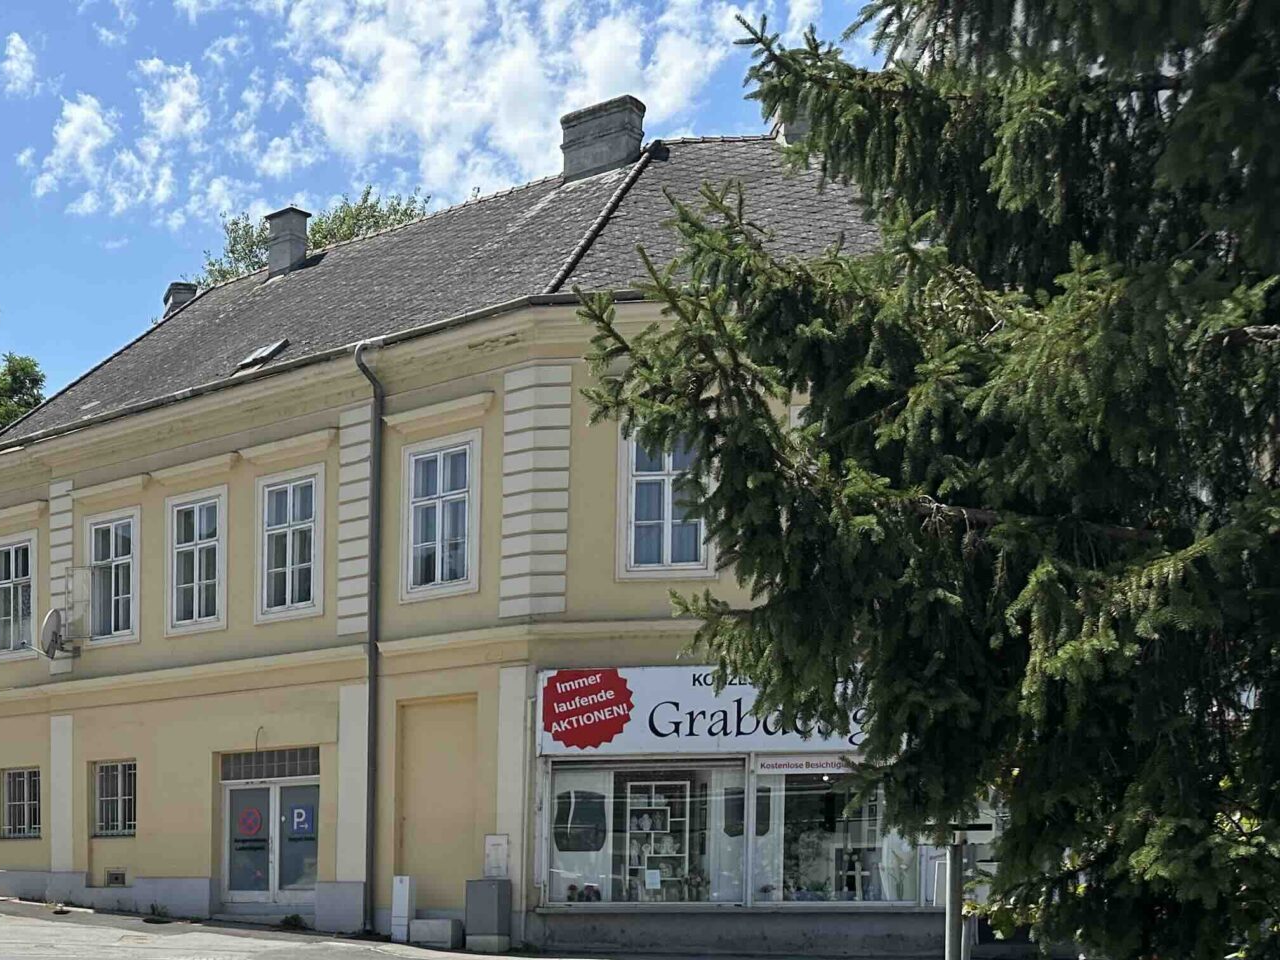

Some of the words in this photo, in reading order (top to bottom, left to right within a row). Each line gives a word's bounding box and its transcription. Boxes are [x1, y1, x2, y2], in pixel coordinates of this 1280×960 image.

[556, 673, 602, 693] Immer
[554, 690, 615, 713] laufende
[552, 703, 629, 733] AKTIONEN!
[293, 808, 306, 831] P
